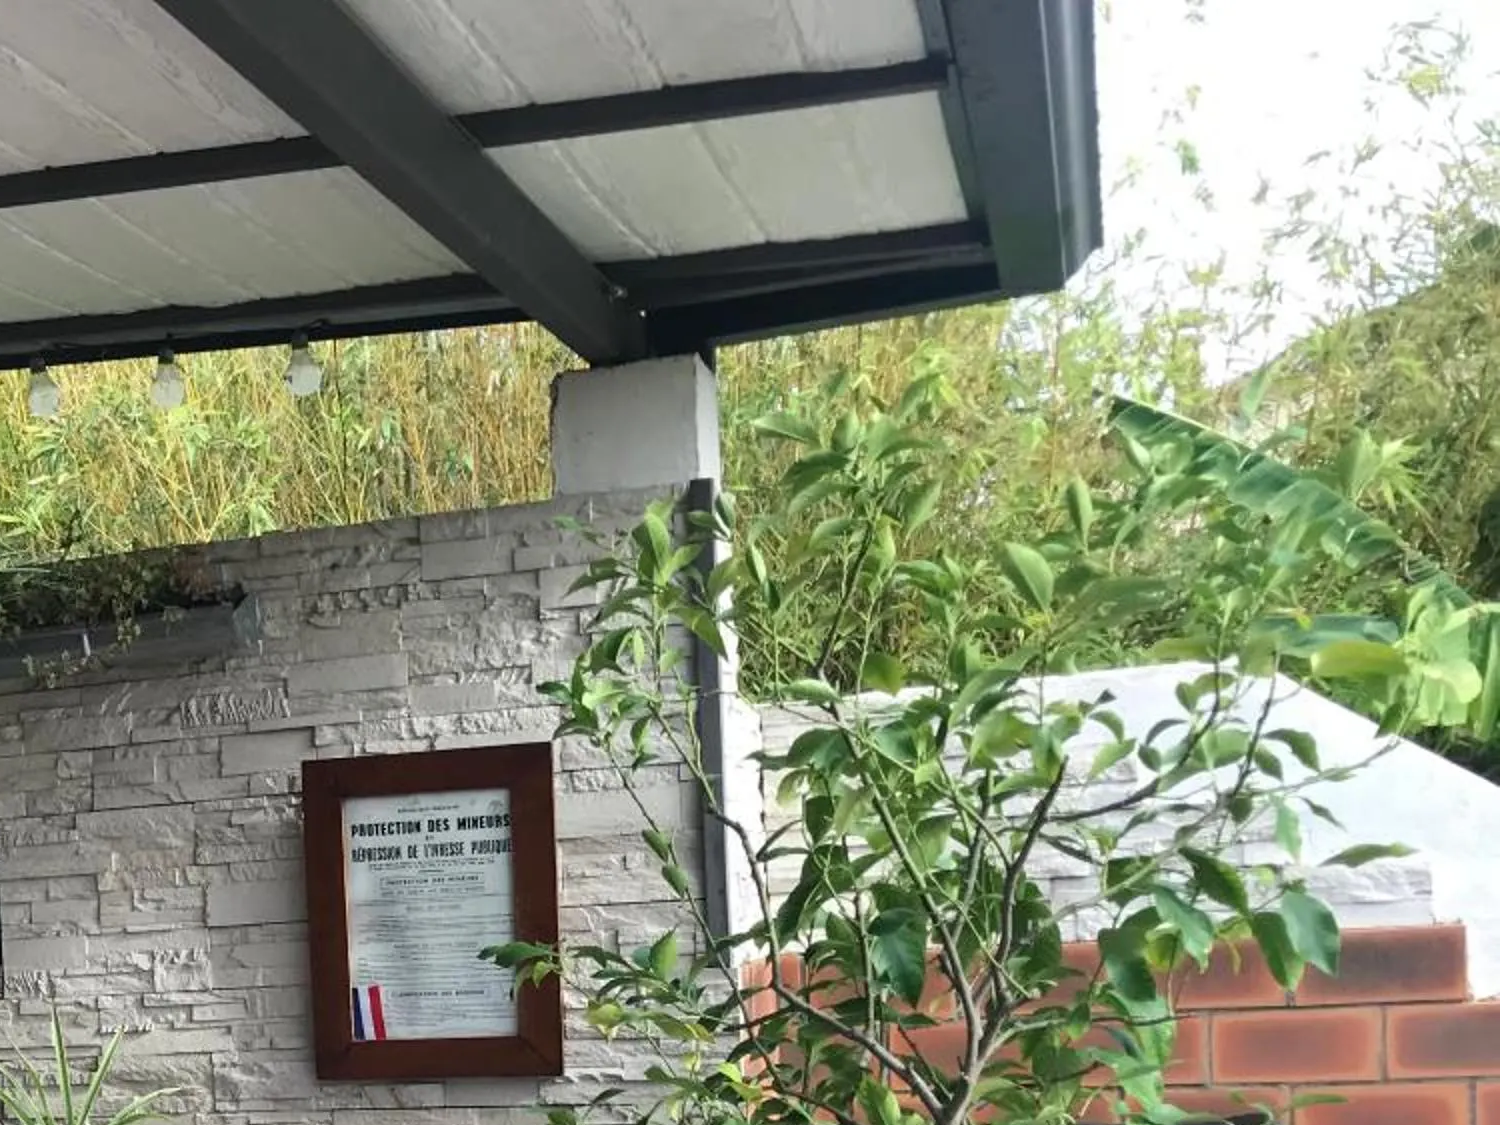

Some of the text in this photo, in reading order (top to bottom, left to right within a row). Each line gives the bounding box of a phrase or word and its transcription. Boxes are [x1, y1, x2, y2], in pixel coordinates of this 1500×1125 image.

[351, 821, 421, 838] PROTECTION
[427, 818, 450, 833] DES
[457, 813, 510, 831] MINEURS
[407, 845, 419, 859] DE
